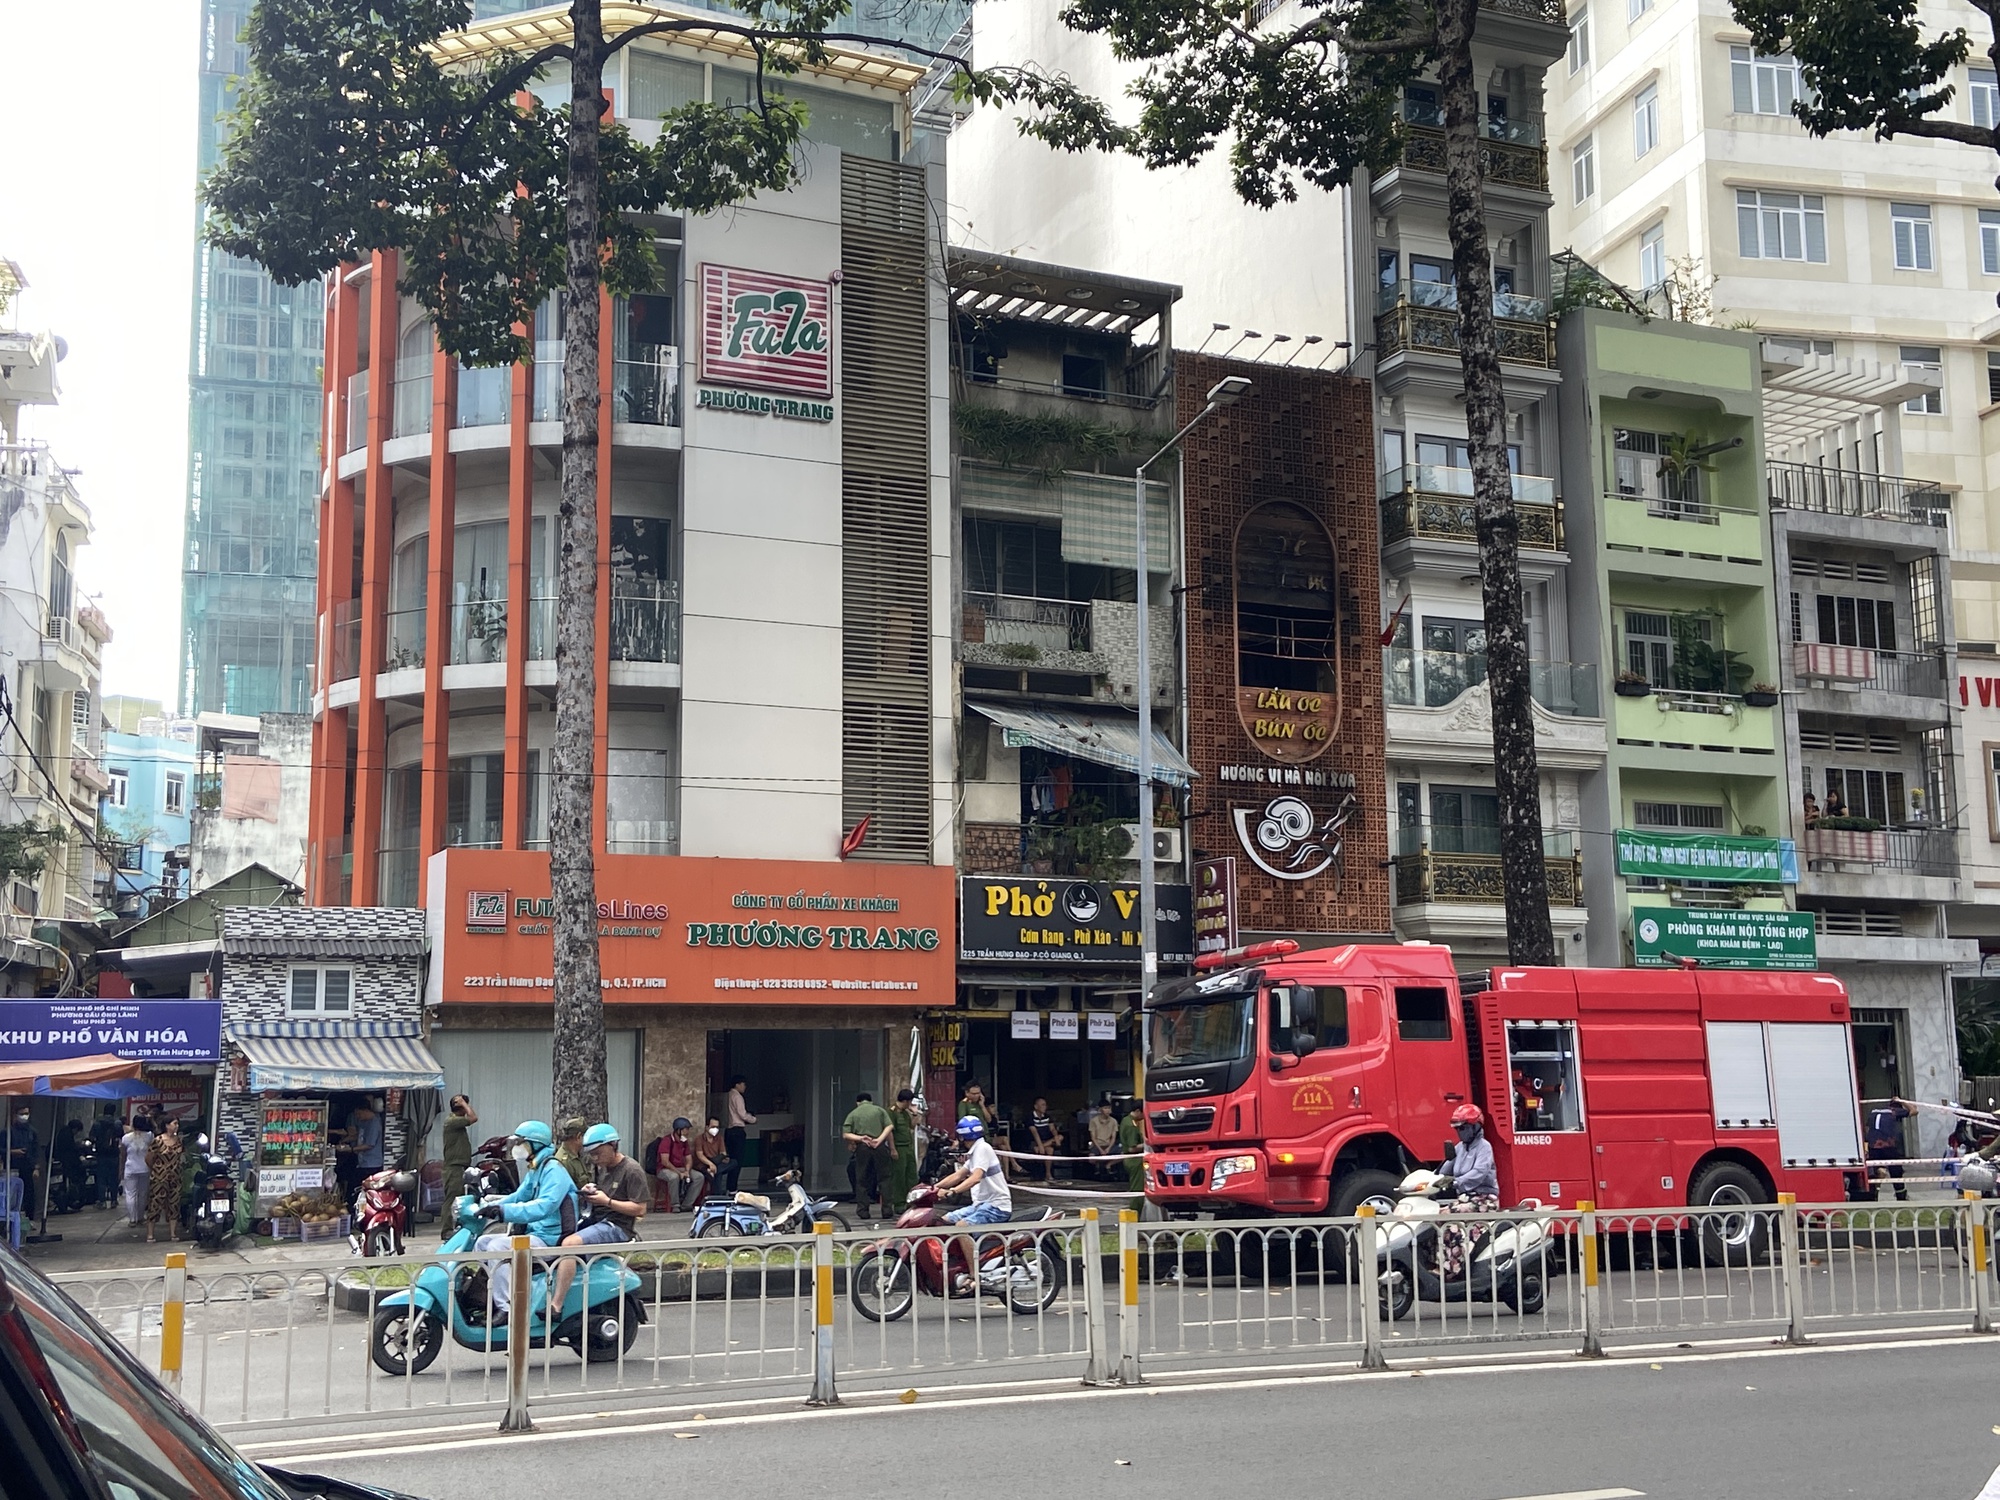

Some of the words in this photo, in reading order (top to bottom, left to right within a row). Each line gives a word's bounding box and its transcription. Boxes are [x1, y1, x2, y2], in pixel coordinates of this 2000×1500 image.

[698, 389, 771, 415] PHƯƠNG
[773, 399, 834, 423] TRANG
[1254, 717, 1295, 738] BÚN
[1221, 764, 1264, 783] HƯƠNG
[1268, 767, 1282, 787] VỊ
[1285, 765, 1301, 784] HÀ
[1305, 768, 1327, 791] NỘI
[1330, 771, 1356, 788] XƯA
[732, 891, 767, 908] CÔNG
[769, 895, 784, 909] TY
[787, 889, 805, 909] CỔ
[806, 892, 839, 911] PHẦN
[842, 897, 857, 911] XE
[859, 895, 899, 912] KHÁCH
[985, 882, 1057, 917] Phở
[1710, 912, 1722, 920] TÂM
[1729, 912, 1736, 920] TẾ
[518, 922, 551, 934] CHẤT
[612, 926, 643, 936] DANH
[686, 919, 823, 949] PHƯƠNG
[827, 926, 940, 951] TRANG
[1668, 921, 1703, 935] PHÒNG
[1706, 923, 1736, 936] KHÁM
[1739, 923, 1756, 939] NỘI
[1759, 922, 1786, 938] TỔNG
[1788, 927, 1809, 940] HỢP
[1020, 928, 1039, 944] Cơm
[1042, 929, 1064, 946] Rang
[1094, 929, 1111, 945] Xào
[1697, 939, 1718, 948] (KHOA
[1720, 939, 1740, 948] KHÁM
[1742, 940, 1760, 950] BỆNH
[1768, 941, 1783, 951] LAO)
[963, 950, 976, 958] 225
[1051, 951, 1072, 959] GIANG
[464, 976, 484, 986] 223
[485, 972, 508, 987] Trần
[509, 976, 534, 988] Hưng
[714, 978, 735, 990] Điện
[0, 1030, 42, 1044] KHU
[48, 1026, 92, 1043] PHỐ
[97, 1027, 139, 1043] VĂN
[145, 1027, 188, 1043] HÓA
[171, 1048, 193, 1057] Hưng
[932, 1047, 956, 1066] 50K
[1156, 1079, 1204, 1092] DAEWOO
[1304, 1092, 1321, 1104] 114
[1514, 1135, 1552, 1145] HANSEO
